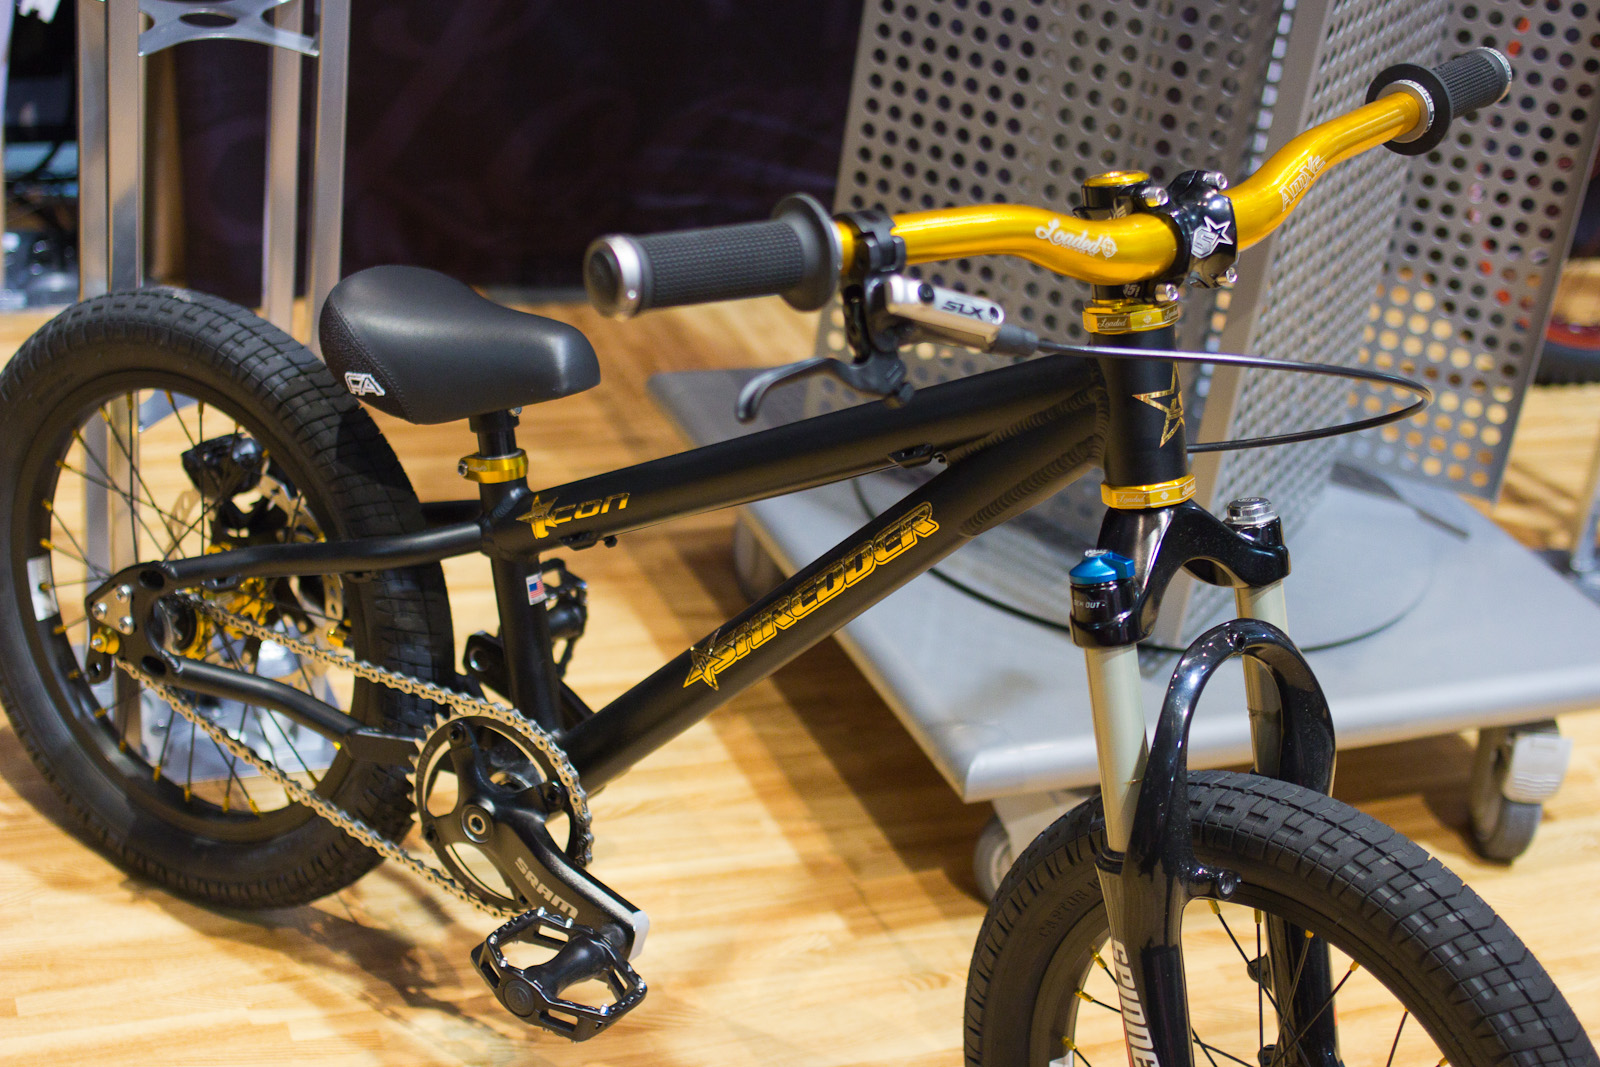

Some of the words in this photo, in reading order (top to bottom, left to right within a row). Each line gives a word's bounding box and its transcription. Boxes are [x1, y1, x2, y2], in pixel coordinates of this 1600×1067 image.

[1035, 219, 1103, 254] Loaded
[941, 300, 984, 320] SLX
[1097, 318, 1127, 328] Loaded
[700, 501, 939, 676] SHREDDER
[514, 857, 578, 919] SRAM
